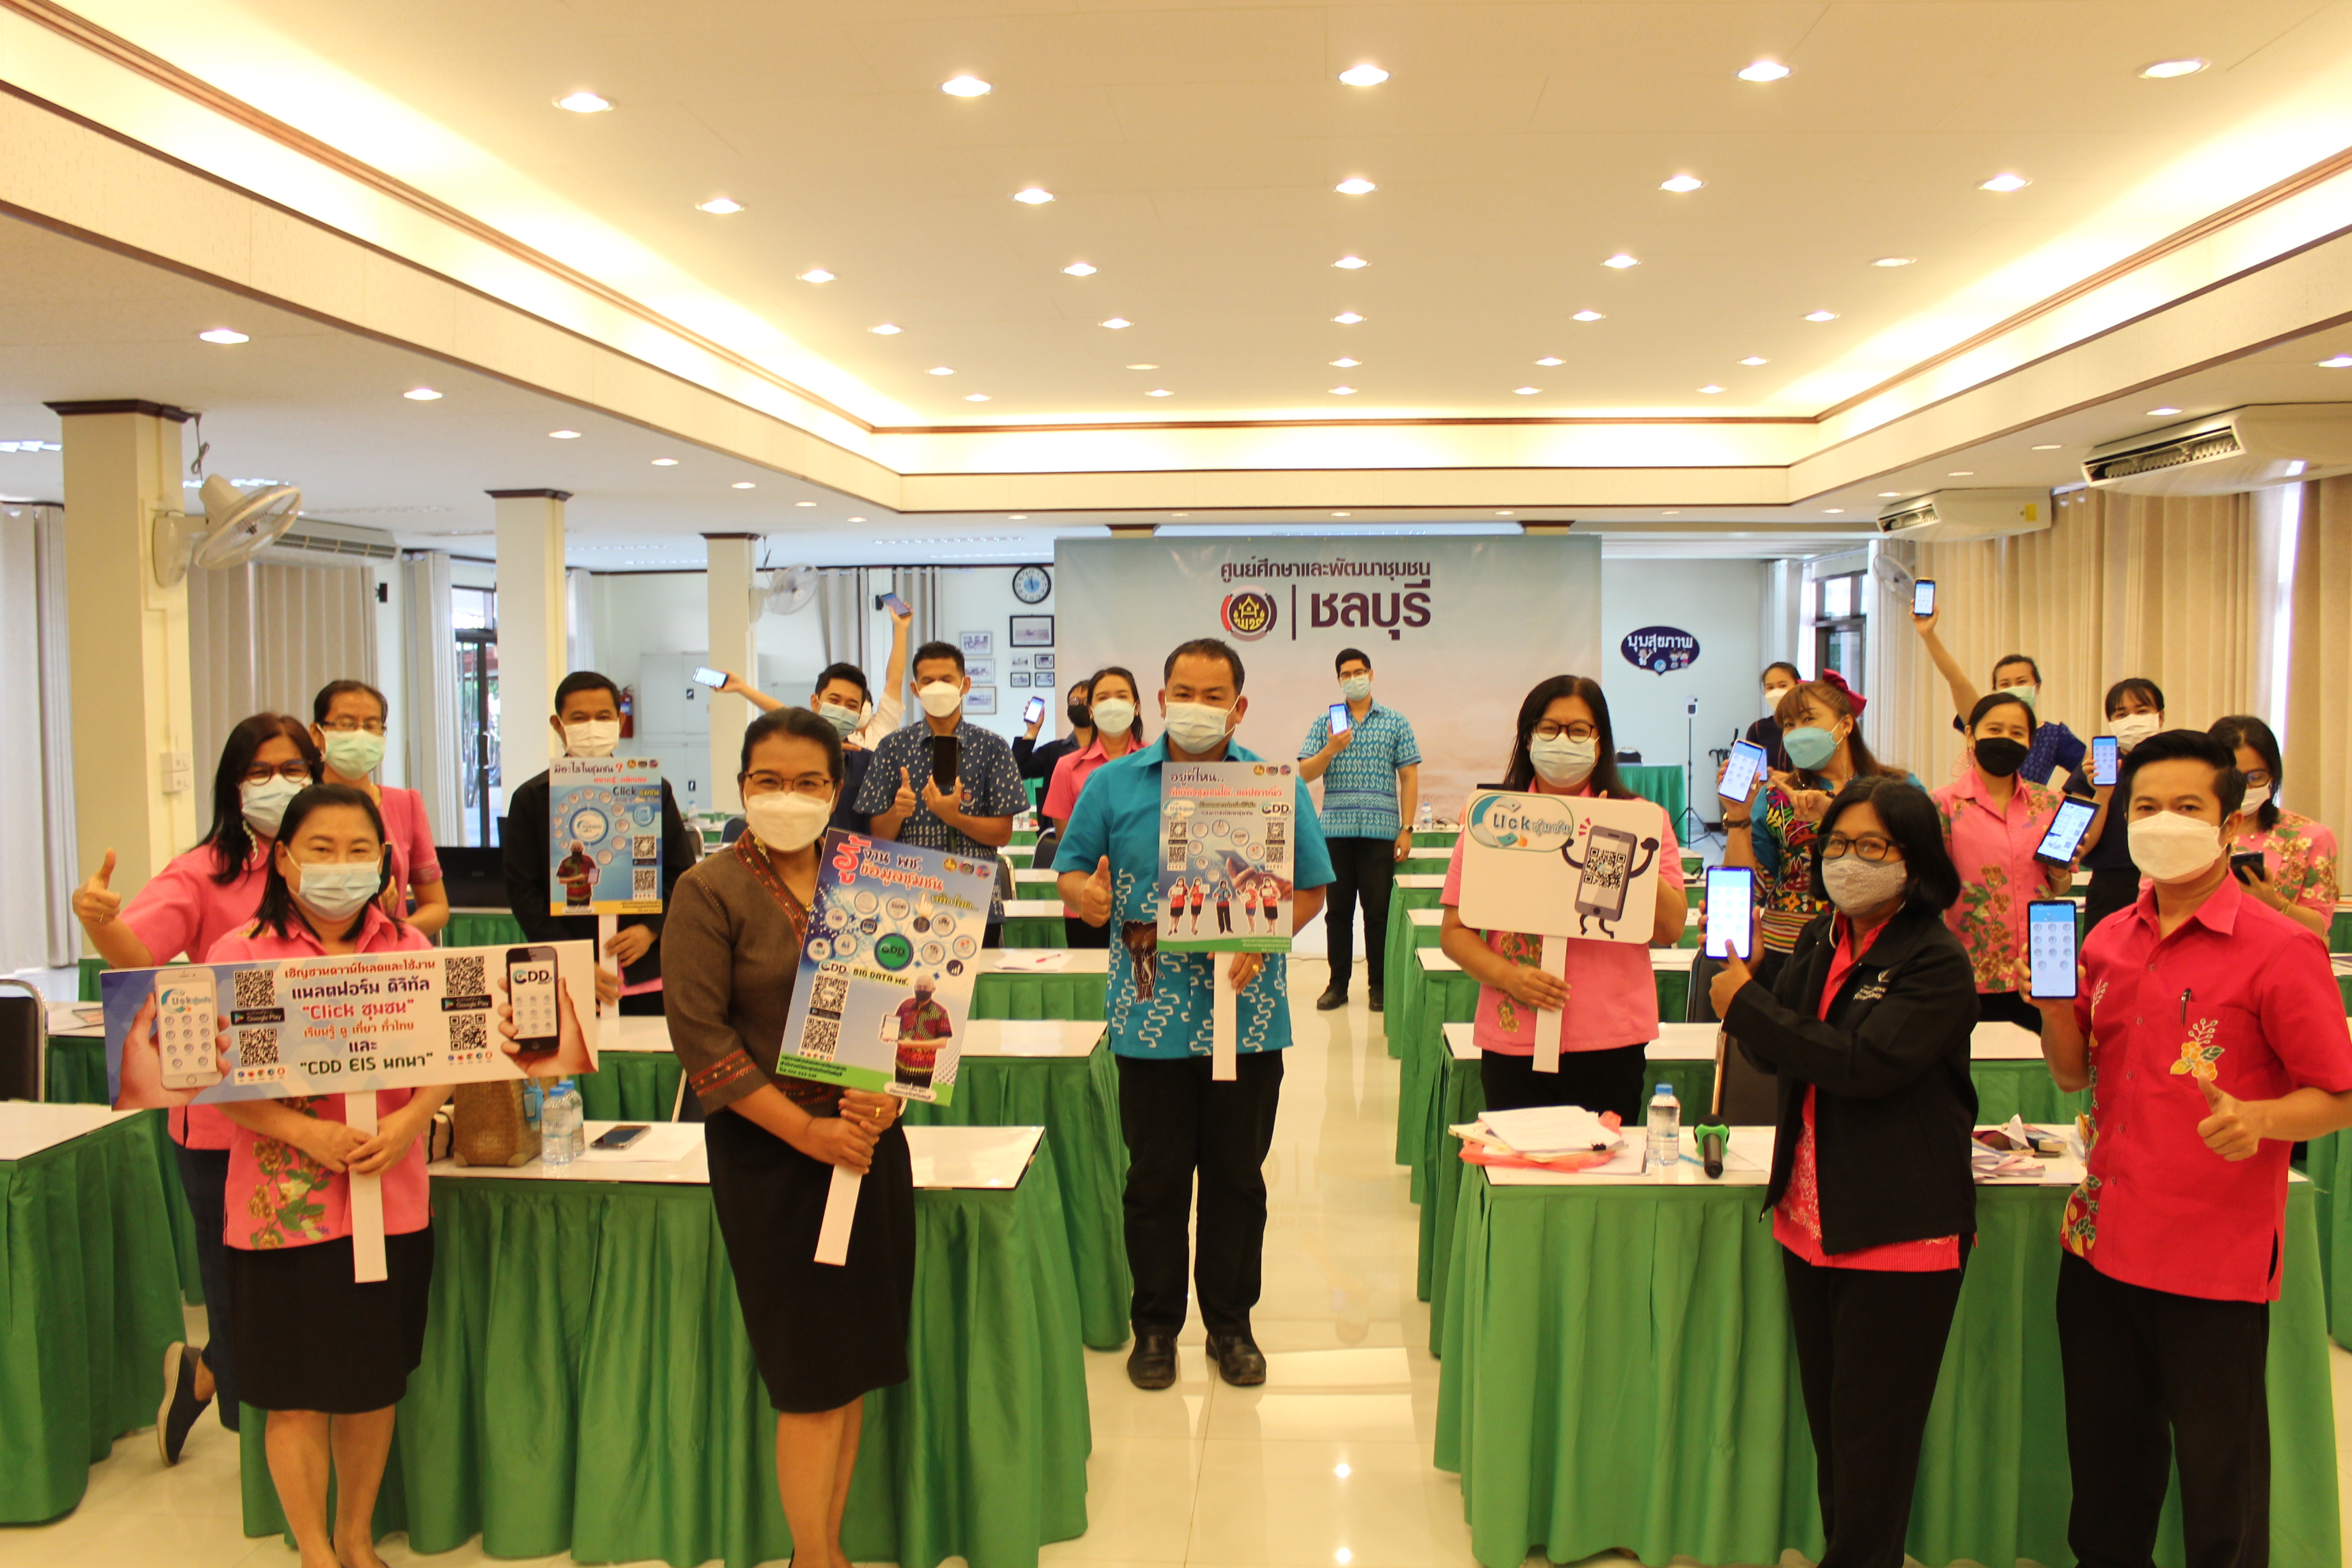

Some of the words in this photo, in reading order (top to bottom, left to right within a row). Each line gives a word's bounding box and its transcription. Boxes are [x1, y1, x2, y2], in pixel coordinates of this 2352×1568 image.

[1220, 557, 1431, 583] ศูนย์ศึกษาและพัฒนาชุมชน
[1311, 579, 1431, 640] ชลบุรี
[1627, 633, 1694, 653] มุมสุขภาพ
[613, 786, 636, 796] Click
[1532, 819, 1571, 836] ชุมชน
[863, 848, 890, 865] งาน
[860, 862, 944, 892] ข้อมูลชุมชน
[853, 968, 868, 977] BIG
[870, 973, 893, 982] DATA
[292, 979, 380, 1000] แพลตฟอร์ม
[388, 976, 430, 993] ดิจิทัล
[353, 1020, 376, 1034] เที่ยว
[349, 1041, 377, 1053] และ
[349, 1056, 376, 1072] EIS
